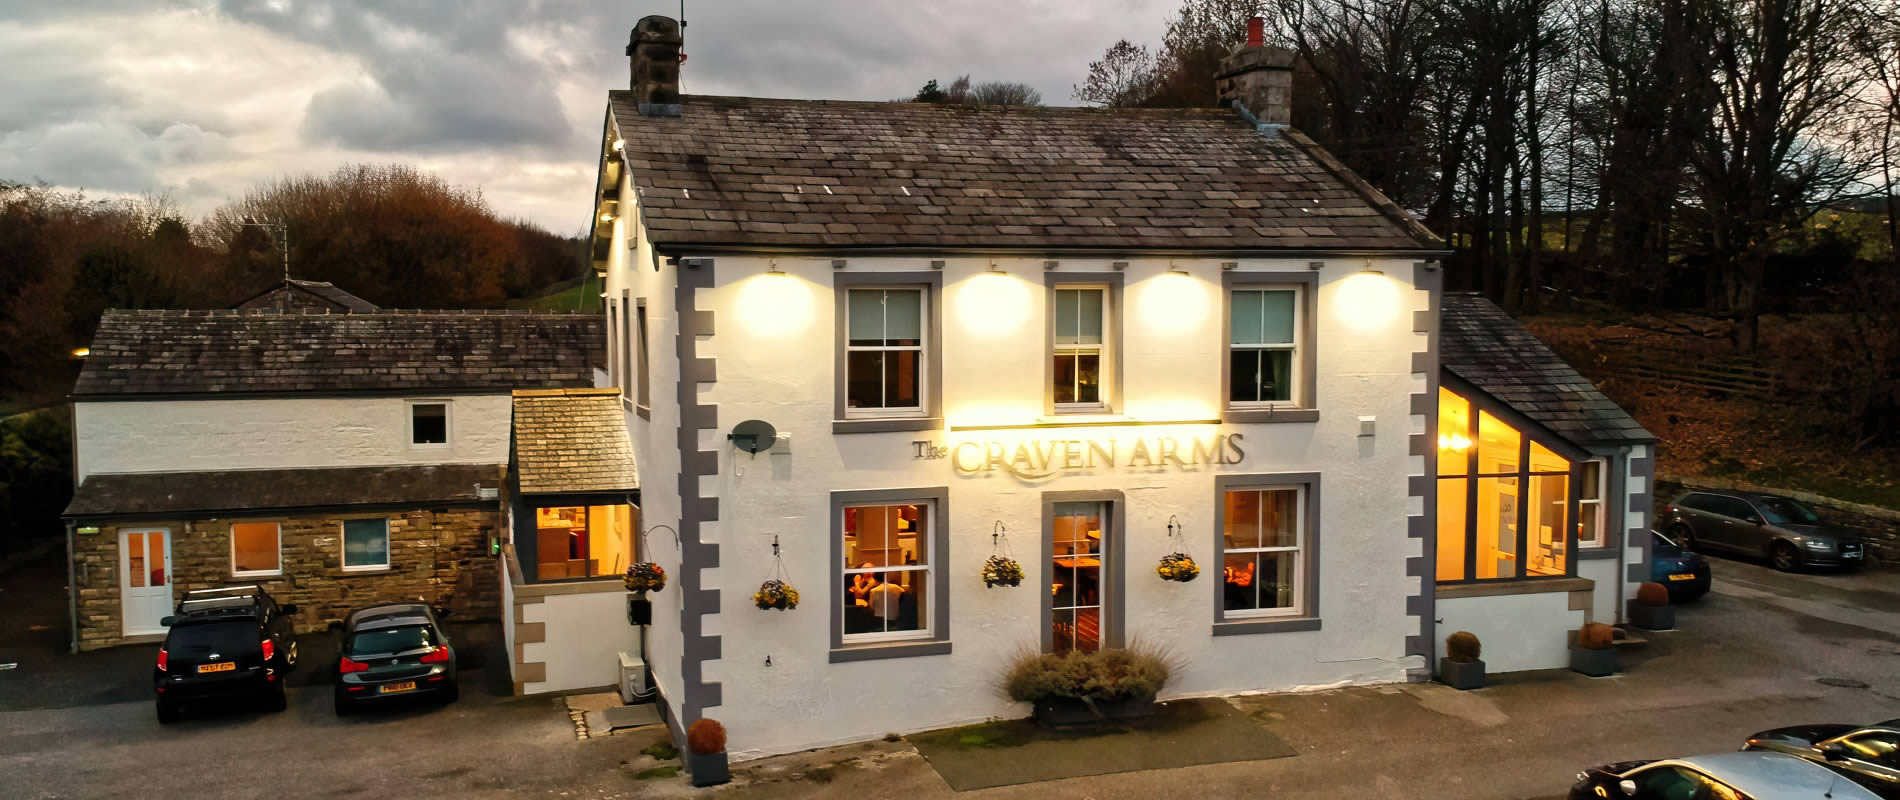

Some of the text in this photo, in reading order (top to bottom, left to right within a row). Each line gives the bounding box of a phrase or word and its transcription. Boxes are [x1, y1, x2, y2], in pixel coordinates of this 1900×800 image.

[911, 433, 1245, 479] The CRAVEN ARMS
